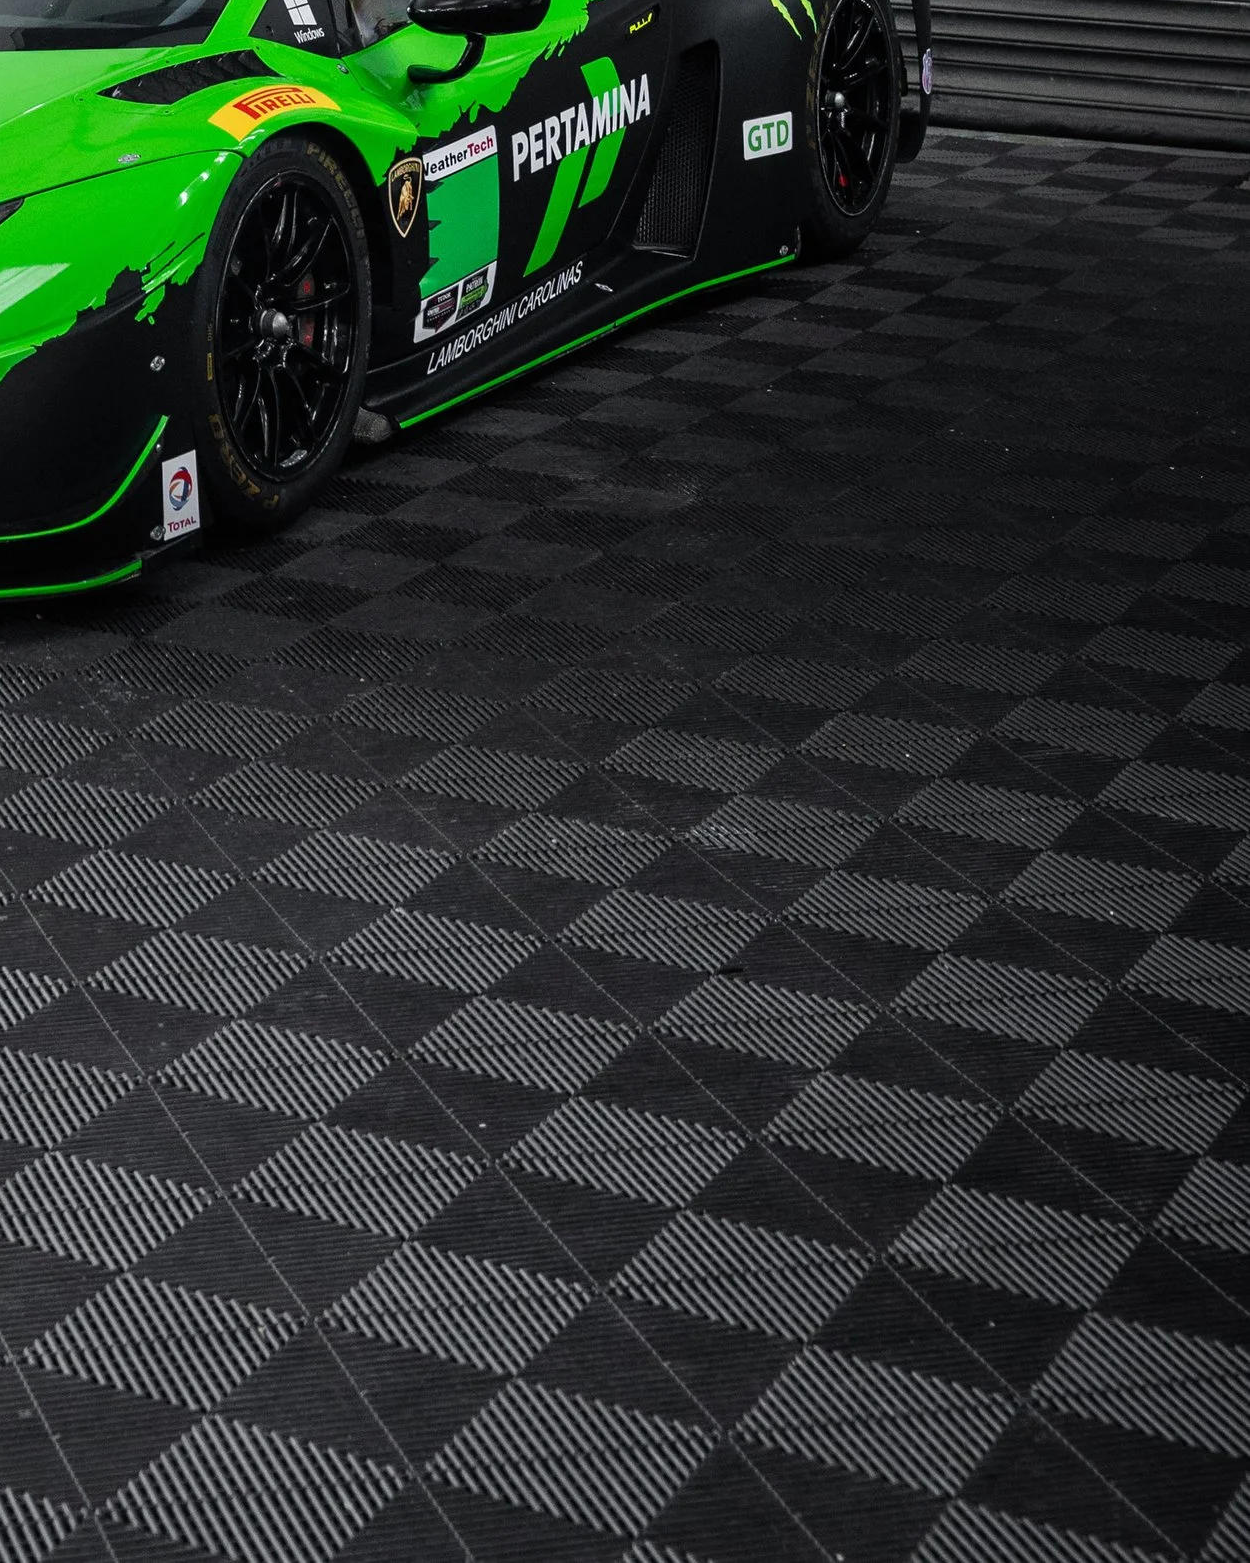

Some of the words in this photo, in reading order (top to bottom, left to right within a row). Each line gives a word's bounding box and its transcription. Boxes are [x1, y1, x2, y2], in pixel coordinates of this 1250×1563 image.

[293, 27, 325, 44] Windows
[232, 87, 316, 120] PIRELLI
[511, 73, 651, 183] PERTAMINA
[748, 120, 789, 152] GTD
[426, 302, 518, 375] LAMBORGHINI
[517, 260, 583, 319] CAROLINAS
[167, 516, 197, 533] TOTAL
